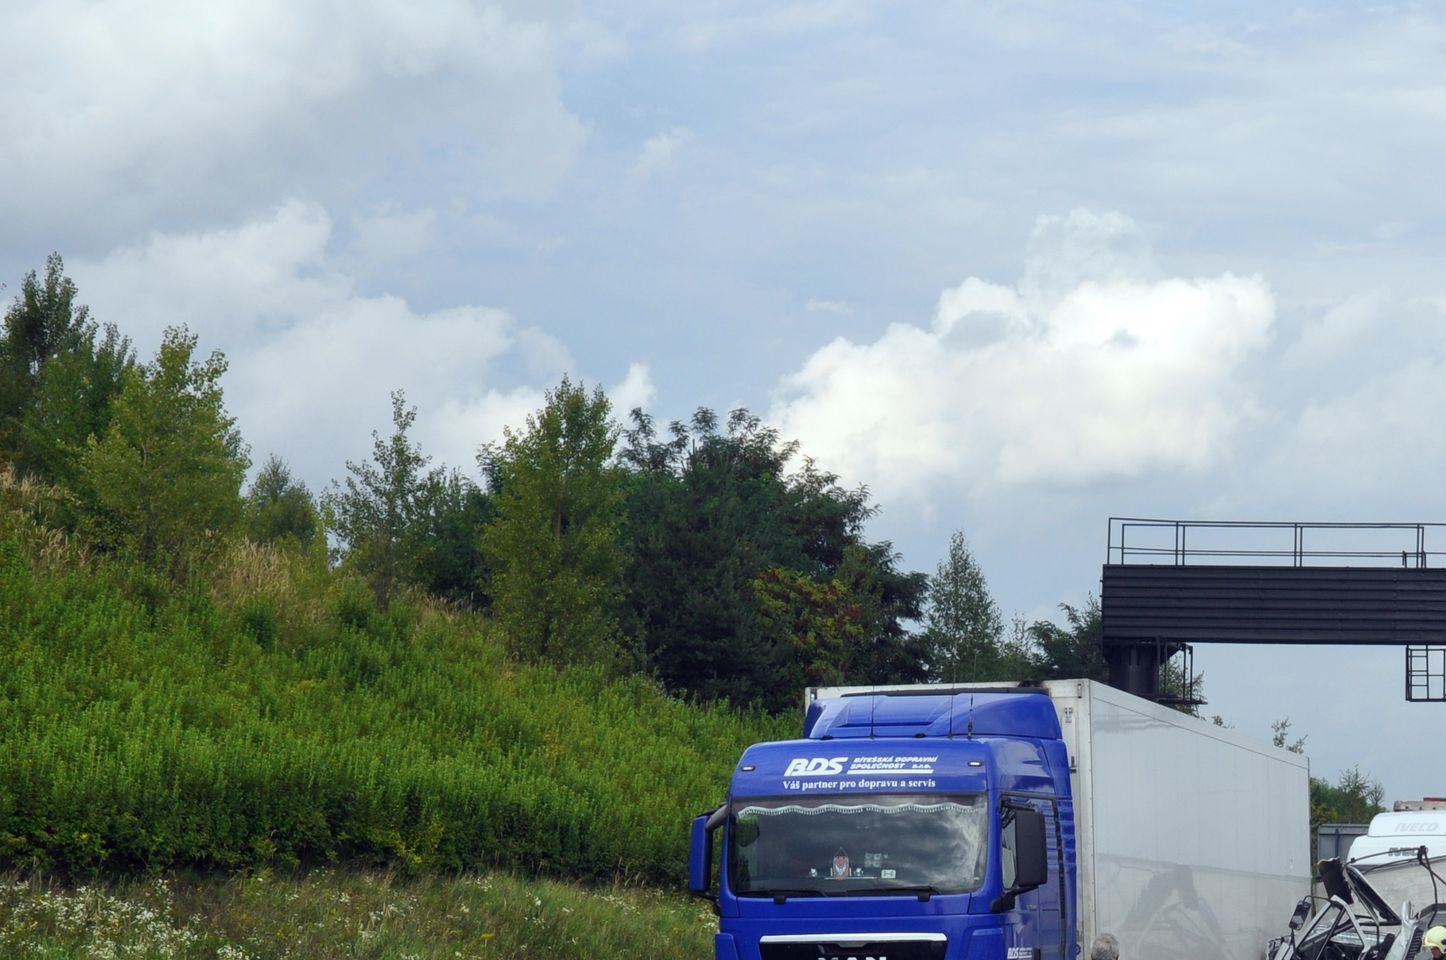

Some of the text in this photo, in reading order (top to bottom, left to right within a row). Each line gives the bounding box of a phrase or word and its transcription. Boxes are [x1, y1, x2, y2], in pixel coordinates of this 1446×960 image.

[784, 757, 849, 777] BDS
[783, 779, 801, 790] Váš
[802, 780, 838, 791] partner
[840, 781, 856, 791] pro
[859, 778, 898, 790] dopravu
[909, 778, 936, 788] servis
